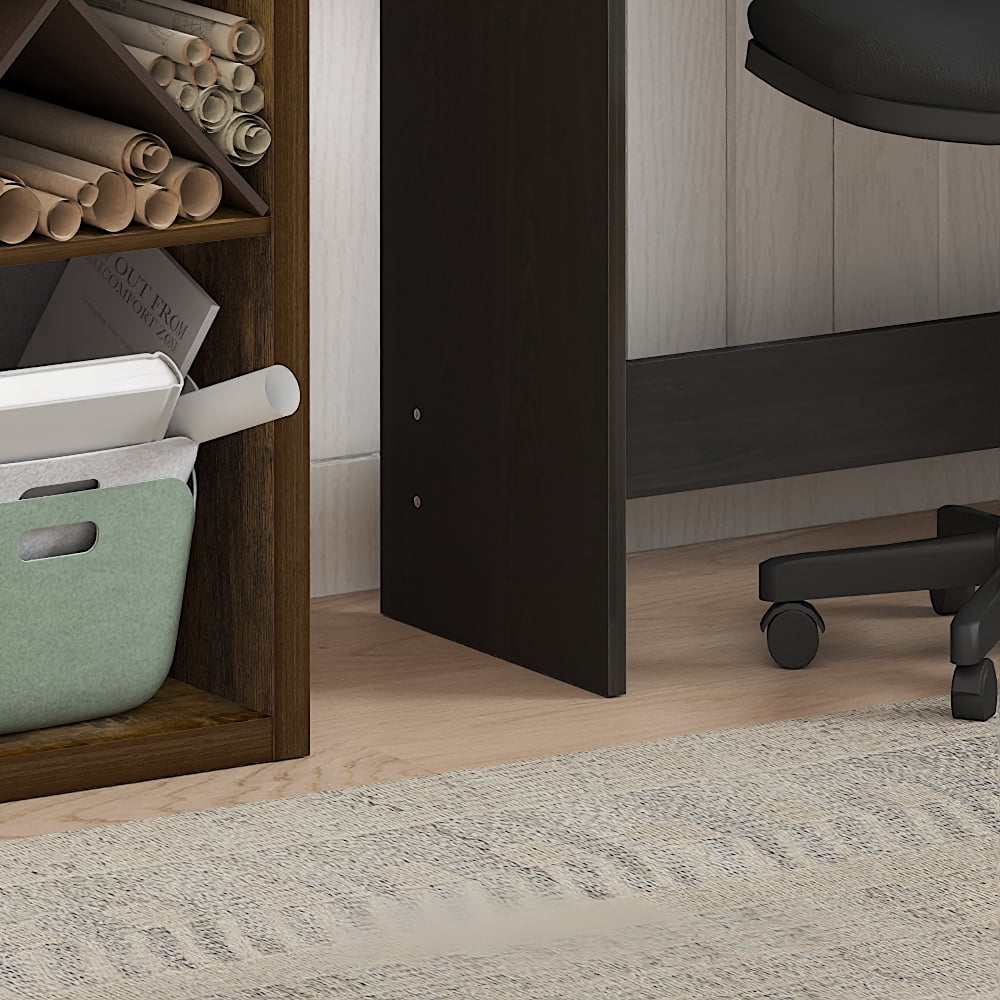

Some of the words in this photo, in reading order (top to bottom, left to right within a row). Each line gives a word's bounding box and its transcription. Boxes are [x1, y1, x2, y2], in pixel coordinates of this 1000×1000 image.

[102, 267, 158, 328] COMFORT
[115, 256, 152, 297] OUT
[150, 293, 188, 340] FROM
